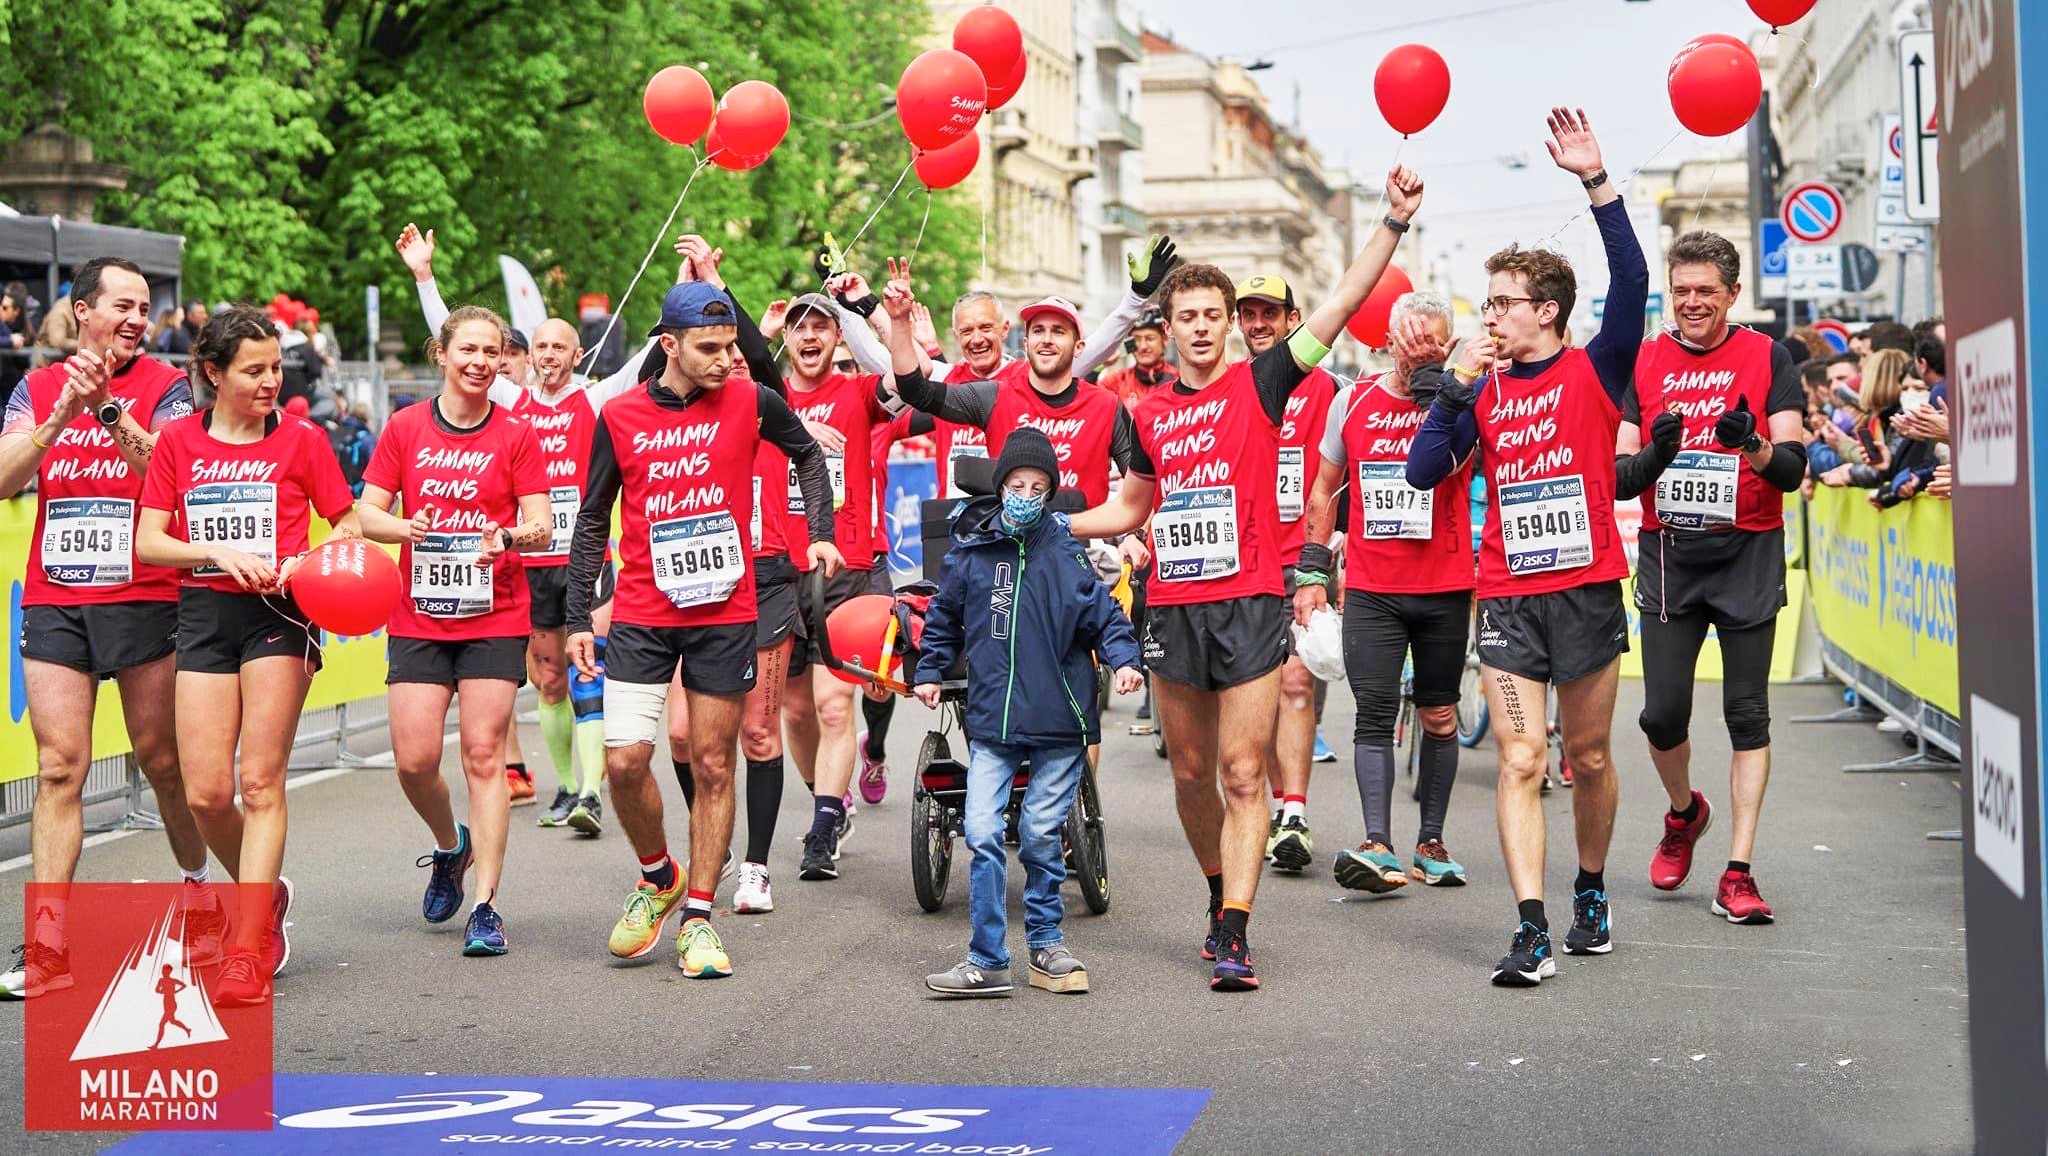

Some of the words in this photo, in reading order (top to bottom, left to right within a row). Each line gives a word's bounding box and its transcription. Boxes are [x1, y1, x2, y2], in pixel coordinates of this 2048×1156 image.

[1661, 371, 1736, 394] SAMMY
[1488, 384, 1563, 424] SAMMY
[1153, 398, 1227, 440] SAMMY
[633, 421, 720, 454] SAMMY
[1161, 428, 1216, 465] RUNS
[1369, 436, 1415, 455] RUN
[1496, 417, 1556, 451] RUNS
[47, 456, 129, 483] MILANO
[191, 458, 278, 482] SAMMY
[415, 446, 494, 475] SAMMY
[648, 452, 711, 483] RUNS
[1495, 444, 1573, 485] MILANO
[419, 477, 478, 500] RUNS
[1160, 457, 1230, 498] MILANO
[644, 482, 724, 518] MILANO
[1375, 490, 1415, 510] 5947
[1671, 480, 1719, 504] 5933
[204, 515, 256, 541] 5939
[431, 508, 487, 531] LANO
[1376, 522, 1397, 533] asics
[1517, 510, 1571, 540] 5940
[1673, 515, 1698, 525] asics
[60, 530, 113, 552] 5943
[1169, 520, 1219, 548] 5948
[671, 546, 724, 576] 5946
[1173, 562, 1199, 575] asics
[1522, 553, 1552, 567] asics
[61, 569, 90, 579] asics
[429, 564, 472, 586] 5941
[680, 586, 708, 600] asics
[991, 562, 1013, 640] CMP
[1886, 526, 1956, 660] Telepass
[427, 601, 453, 612] asics
[512, 1099, 990, 1134] asics
[440, 1132, 603, 1145] sound
[602, 1135, 737, 1151] mind,
[749, 1138, 915, 1153] sound
[915, 1141, 1054, 1156] body
